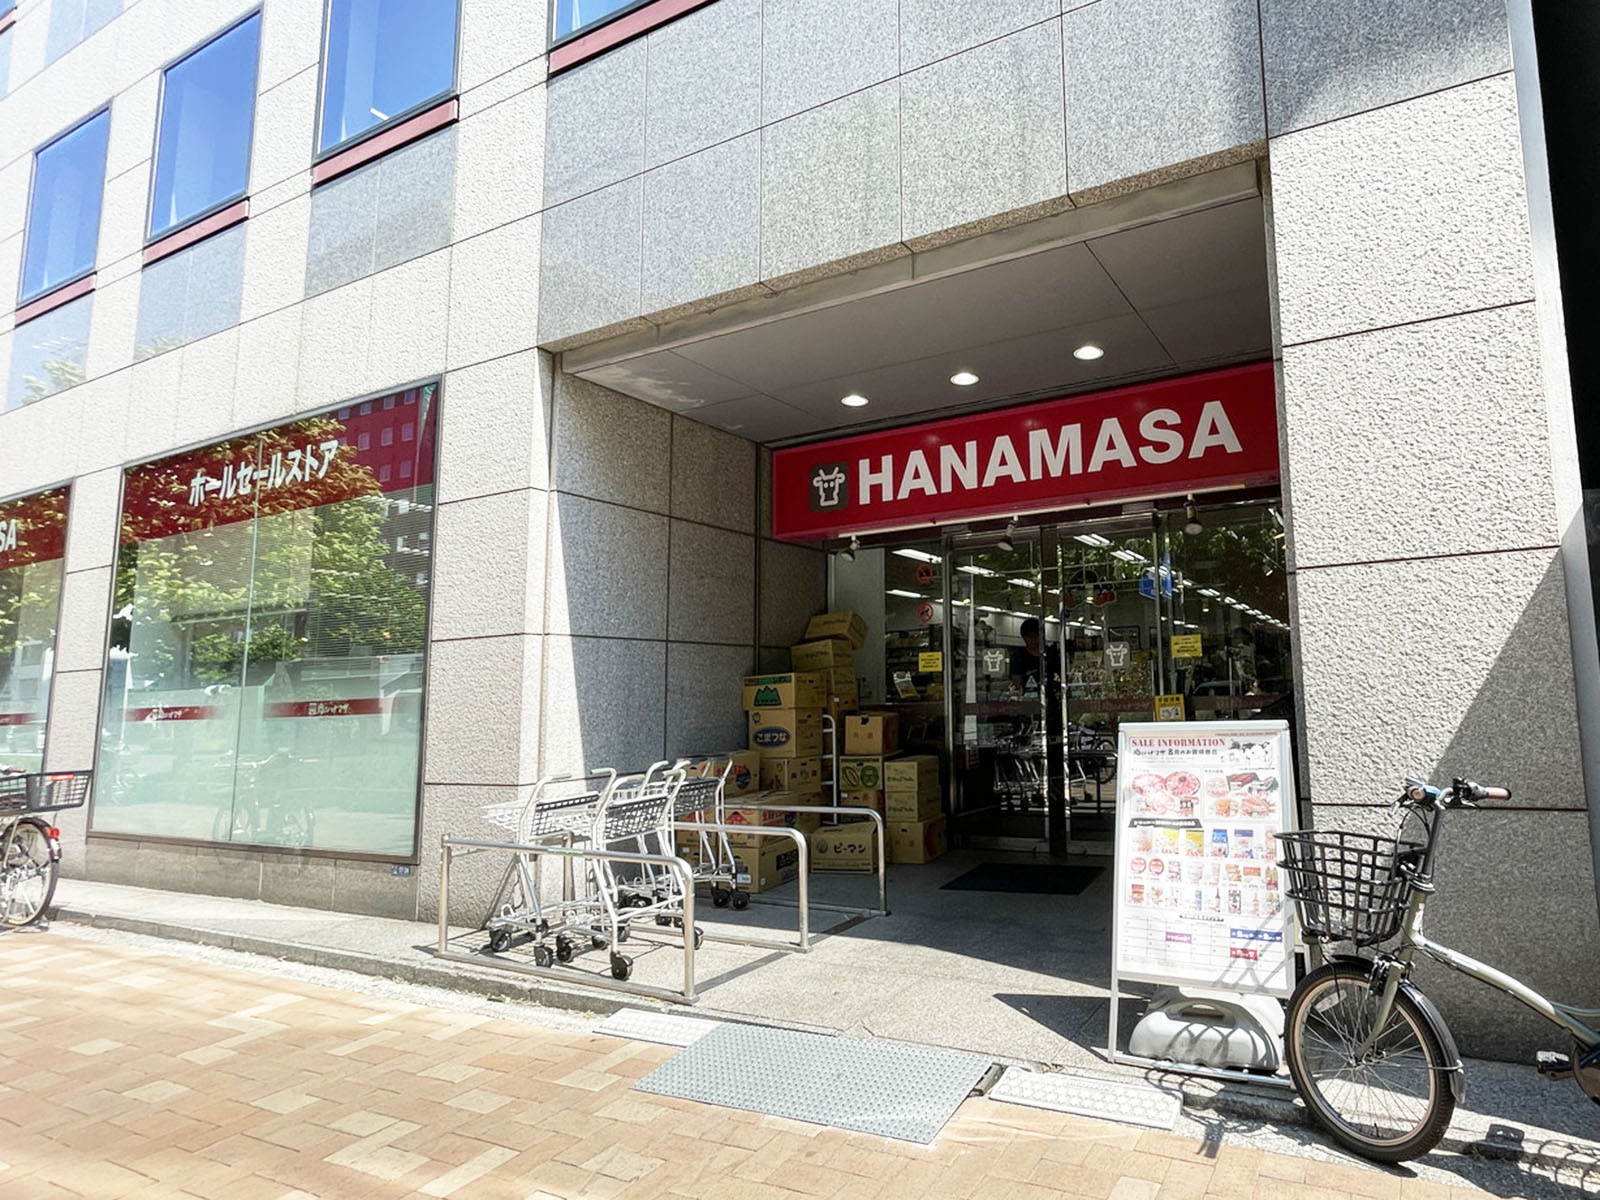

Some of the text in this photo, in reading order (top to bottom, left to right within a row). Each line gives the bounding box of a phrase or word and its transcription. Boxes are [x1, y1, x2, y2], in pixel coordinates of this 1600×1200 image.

[858, 401, 1242, 506] HANAMASA
[189, 440, 338, 506] ホールセールストア
[757, 731, 787, 744] こまつな
[1132, 738, 1226, 748] SALE INFORMATION
[833, 842, 867, 854] ピーマン
